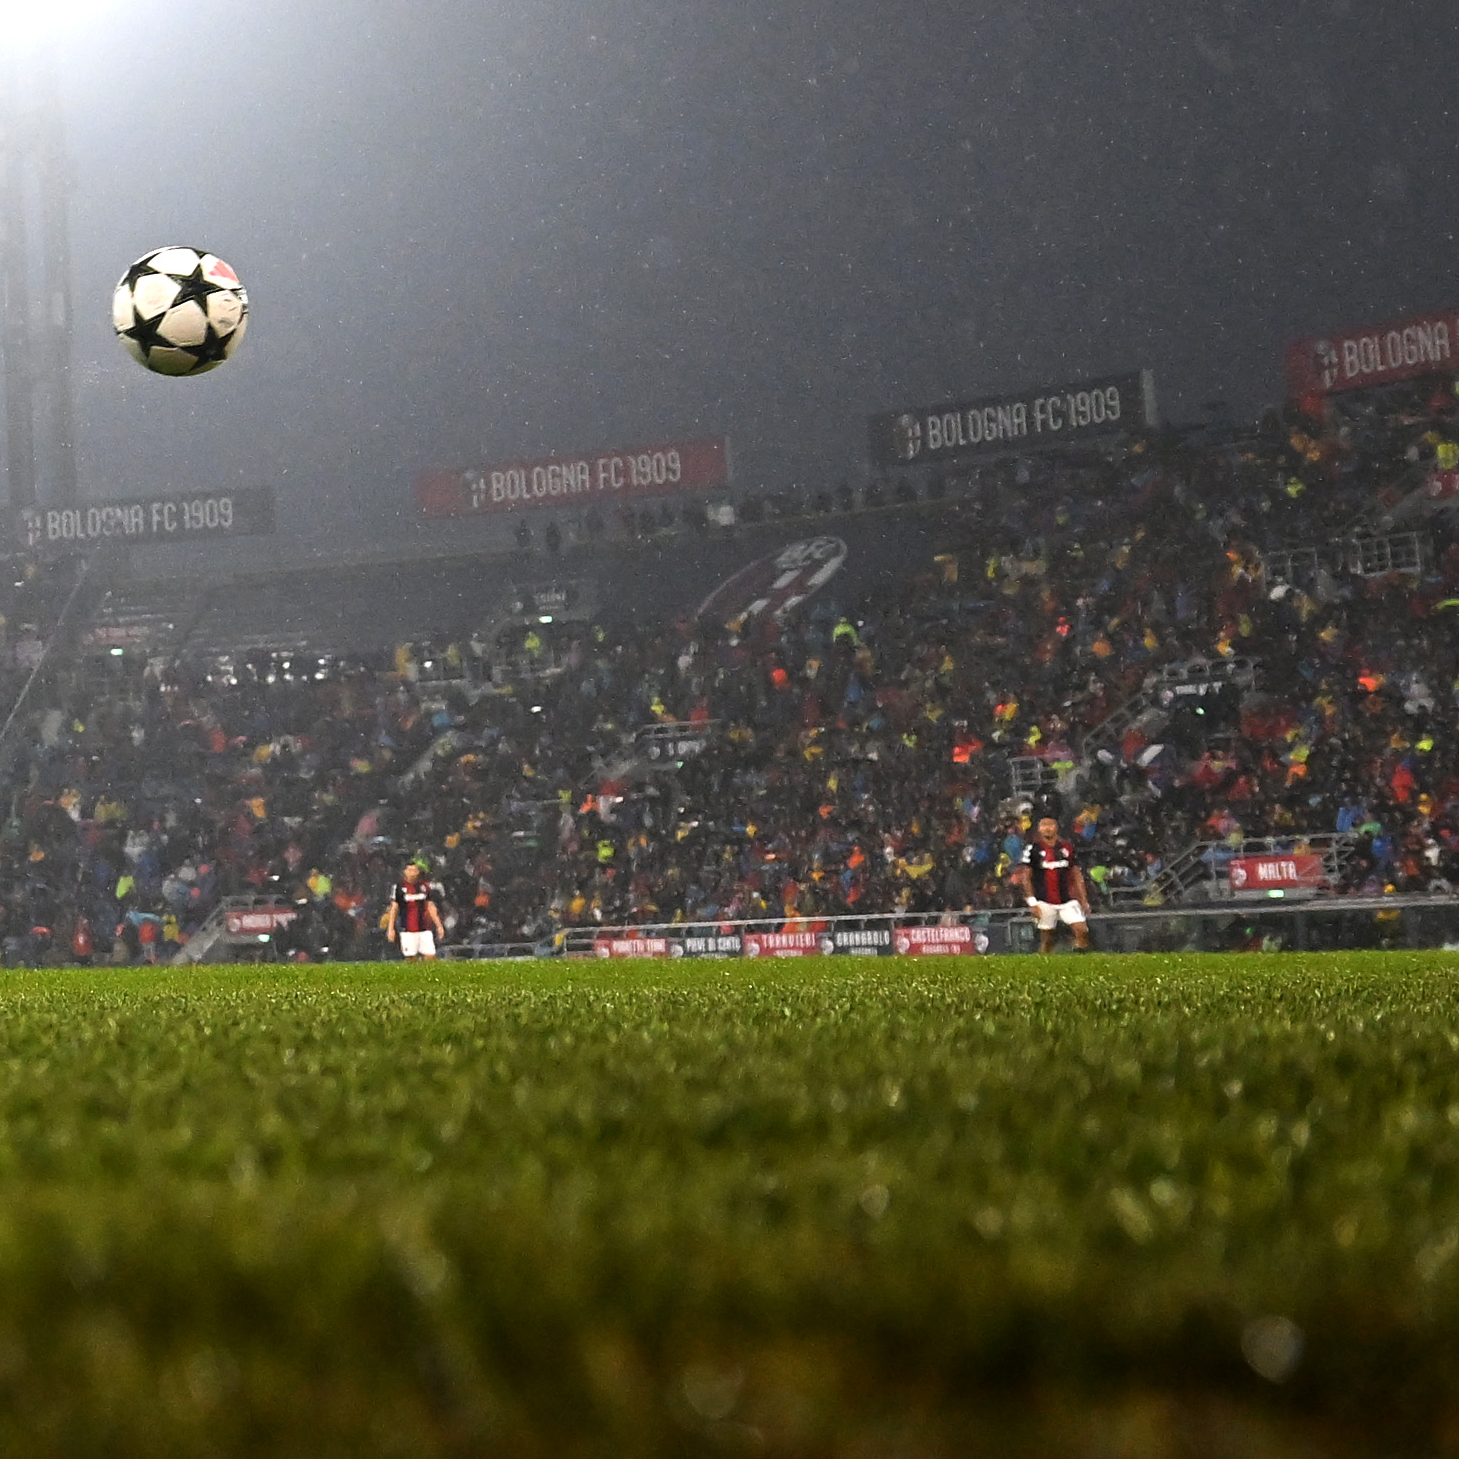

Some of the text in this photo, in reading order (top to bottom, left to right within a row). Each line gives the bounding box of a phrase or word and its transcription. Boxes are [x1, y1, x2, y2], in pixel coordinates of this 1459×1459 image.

[1343, 321, 1451, 379] BOLOGNA
[927, 386, 1121, 449] BOLOGNA FC 1909
[491, 450, 681, 502] BOLOGNA FC 1909
[47, 498, 232, 540] BOLOGNA FC 1909
[1258, 861, 1297, 880] MALTA
[911, 927, 970, 943] CASTELFRANCO
